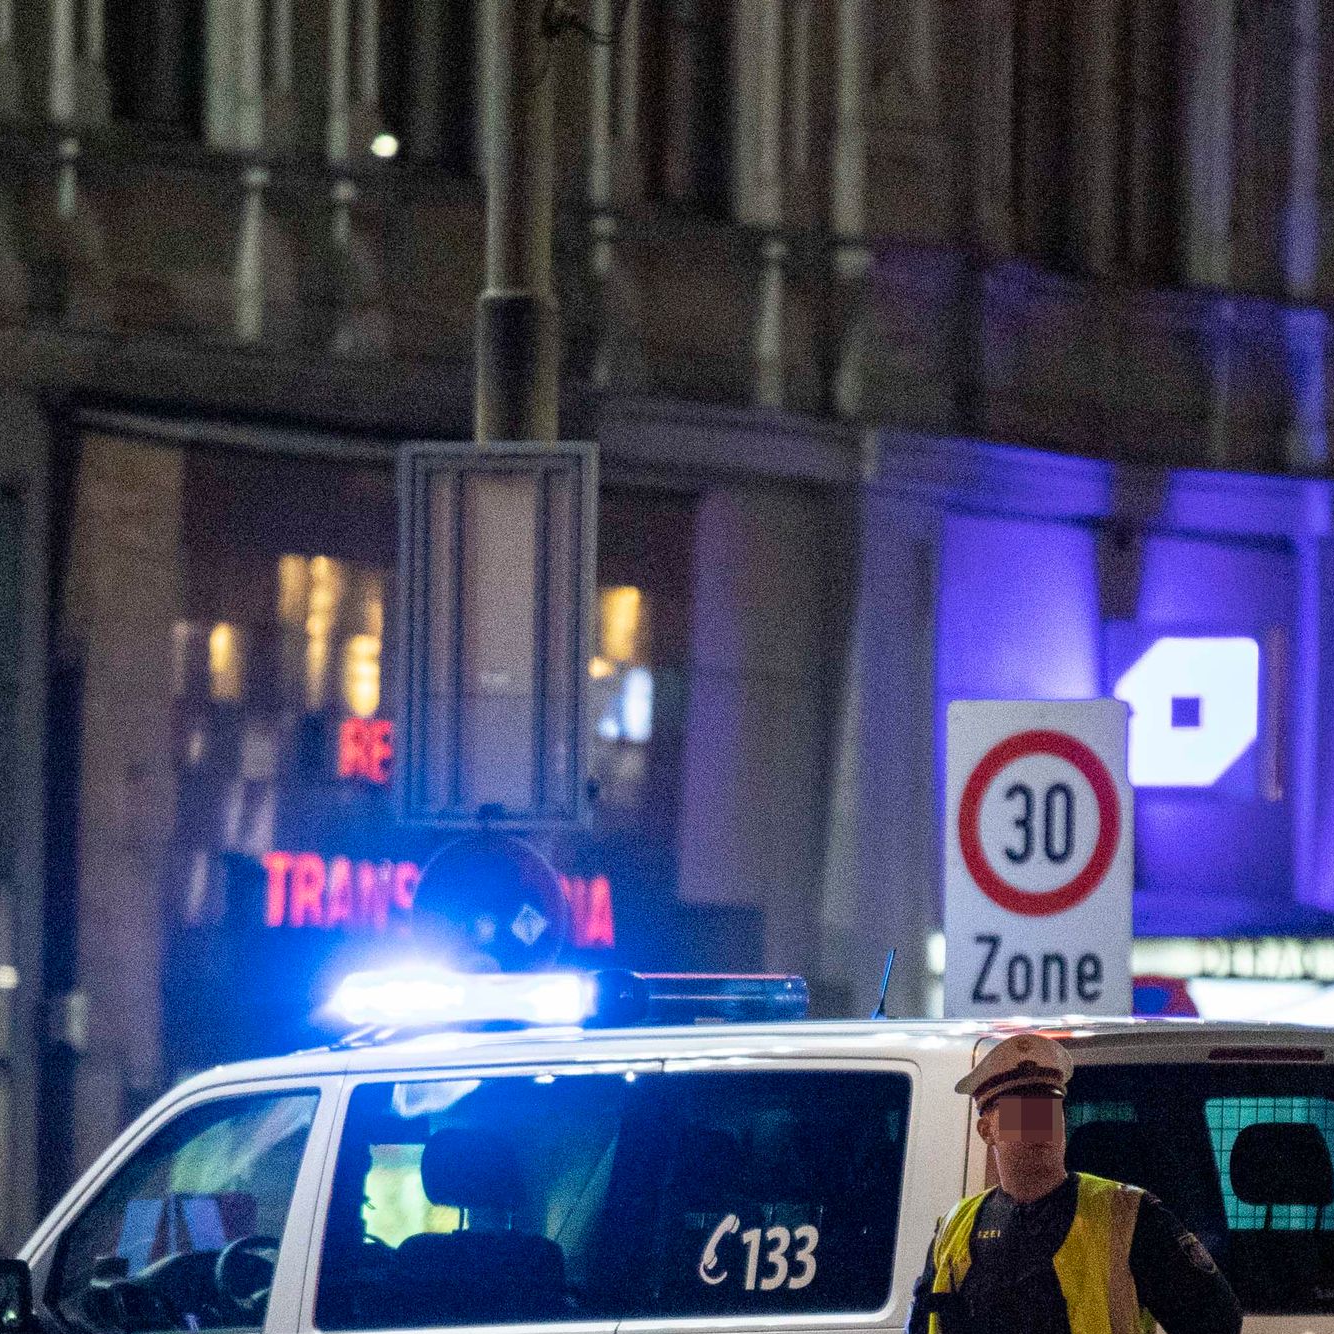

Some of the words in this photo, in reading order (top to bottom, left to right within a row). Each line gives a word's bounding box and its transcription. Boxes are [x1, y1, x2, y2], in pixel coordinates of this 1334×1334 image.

[1004, 782, 1076, 864] 30
[970, 932, 1105, 1004] Zone
[742, 1225, 820, 1290] 133
